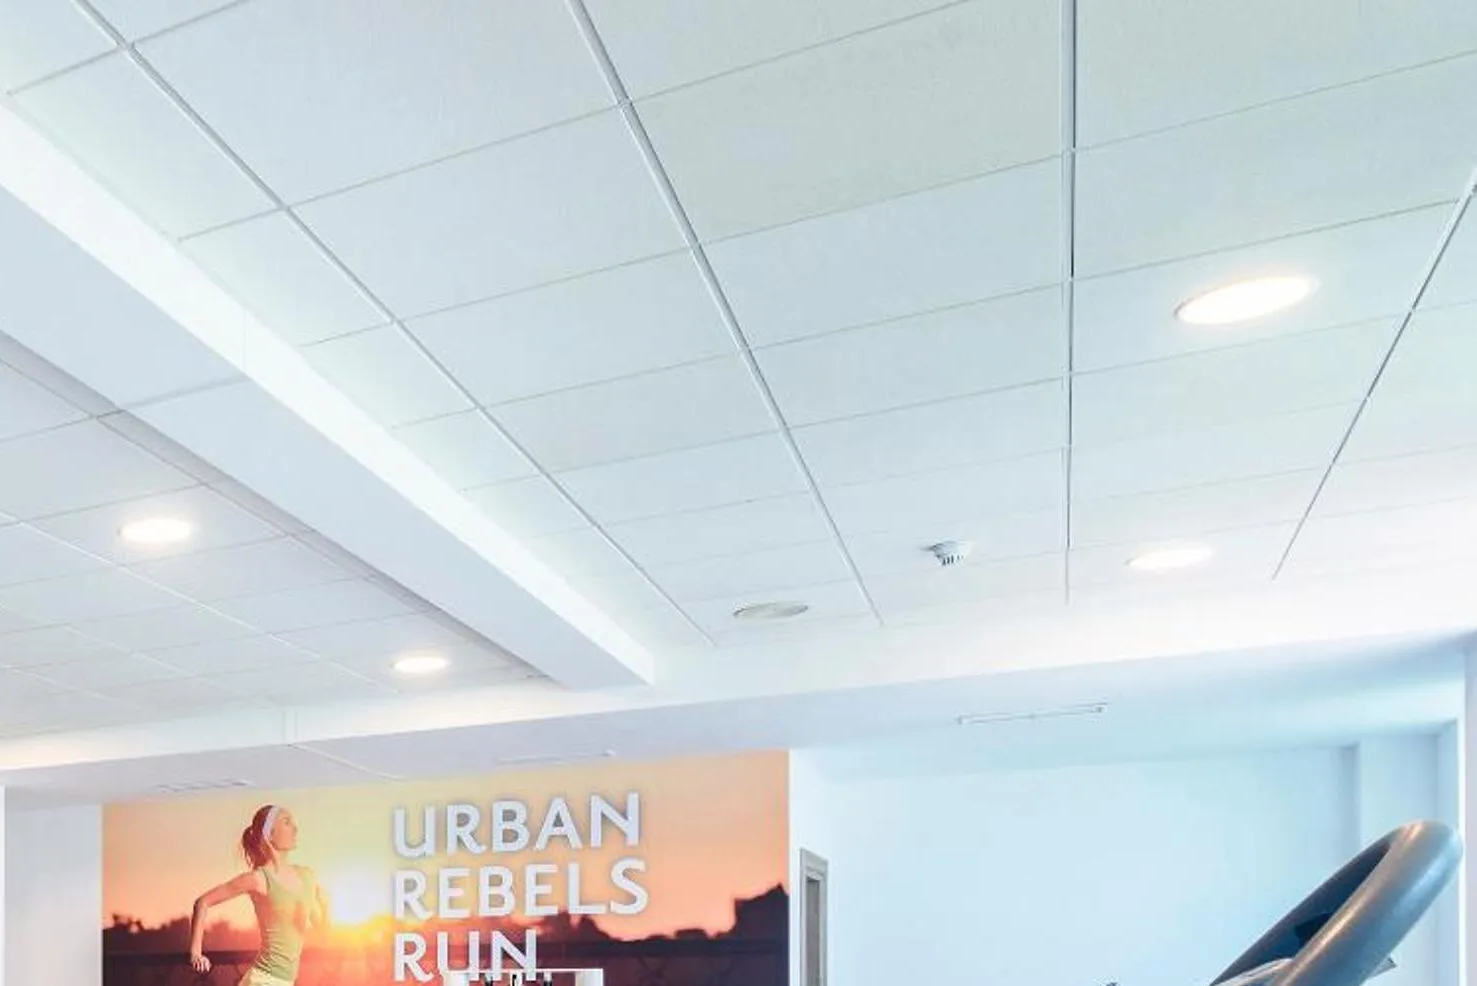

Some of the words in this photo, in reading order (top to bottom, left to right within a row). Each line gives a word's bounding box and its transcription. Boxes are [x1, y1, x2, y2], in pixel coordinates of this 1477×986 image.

[391, 791, 641, 859] URBAN
[393, 857, 649, 921] REBELS
[393, 928, 538, 983] RUN
